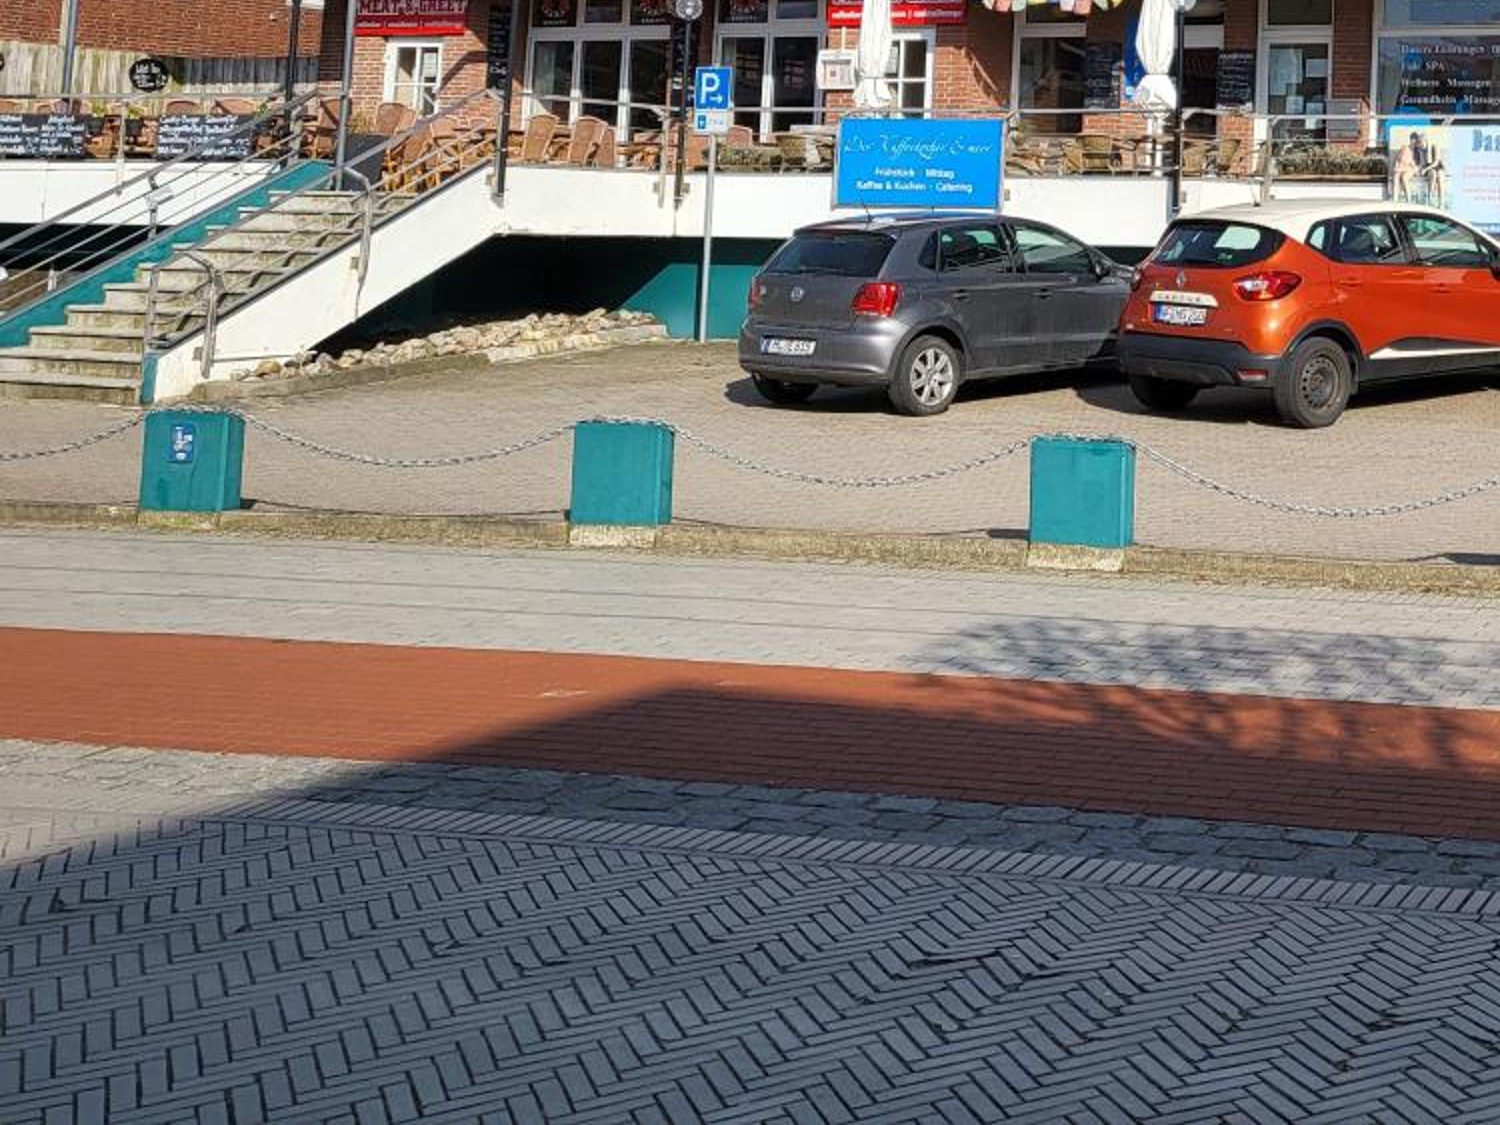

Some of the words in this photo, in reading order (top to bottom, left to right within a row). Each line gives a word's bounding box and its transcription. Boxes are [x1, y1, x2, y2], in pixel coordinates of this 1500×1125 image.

[701, 73, 720, 103] P
[856, 181, 883, 191] Kaffee
[894, 181, 927, 191] Kuchen
[935, 181, 973, 193] Catering
